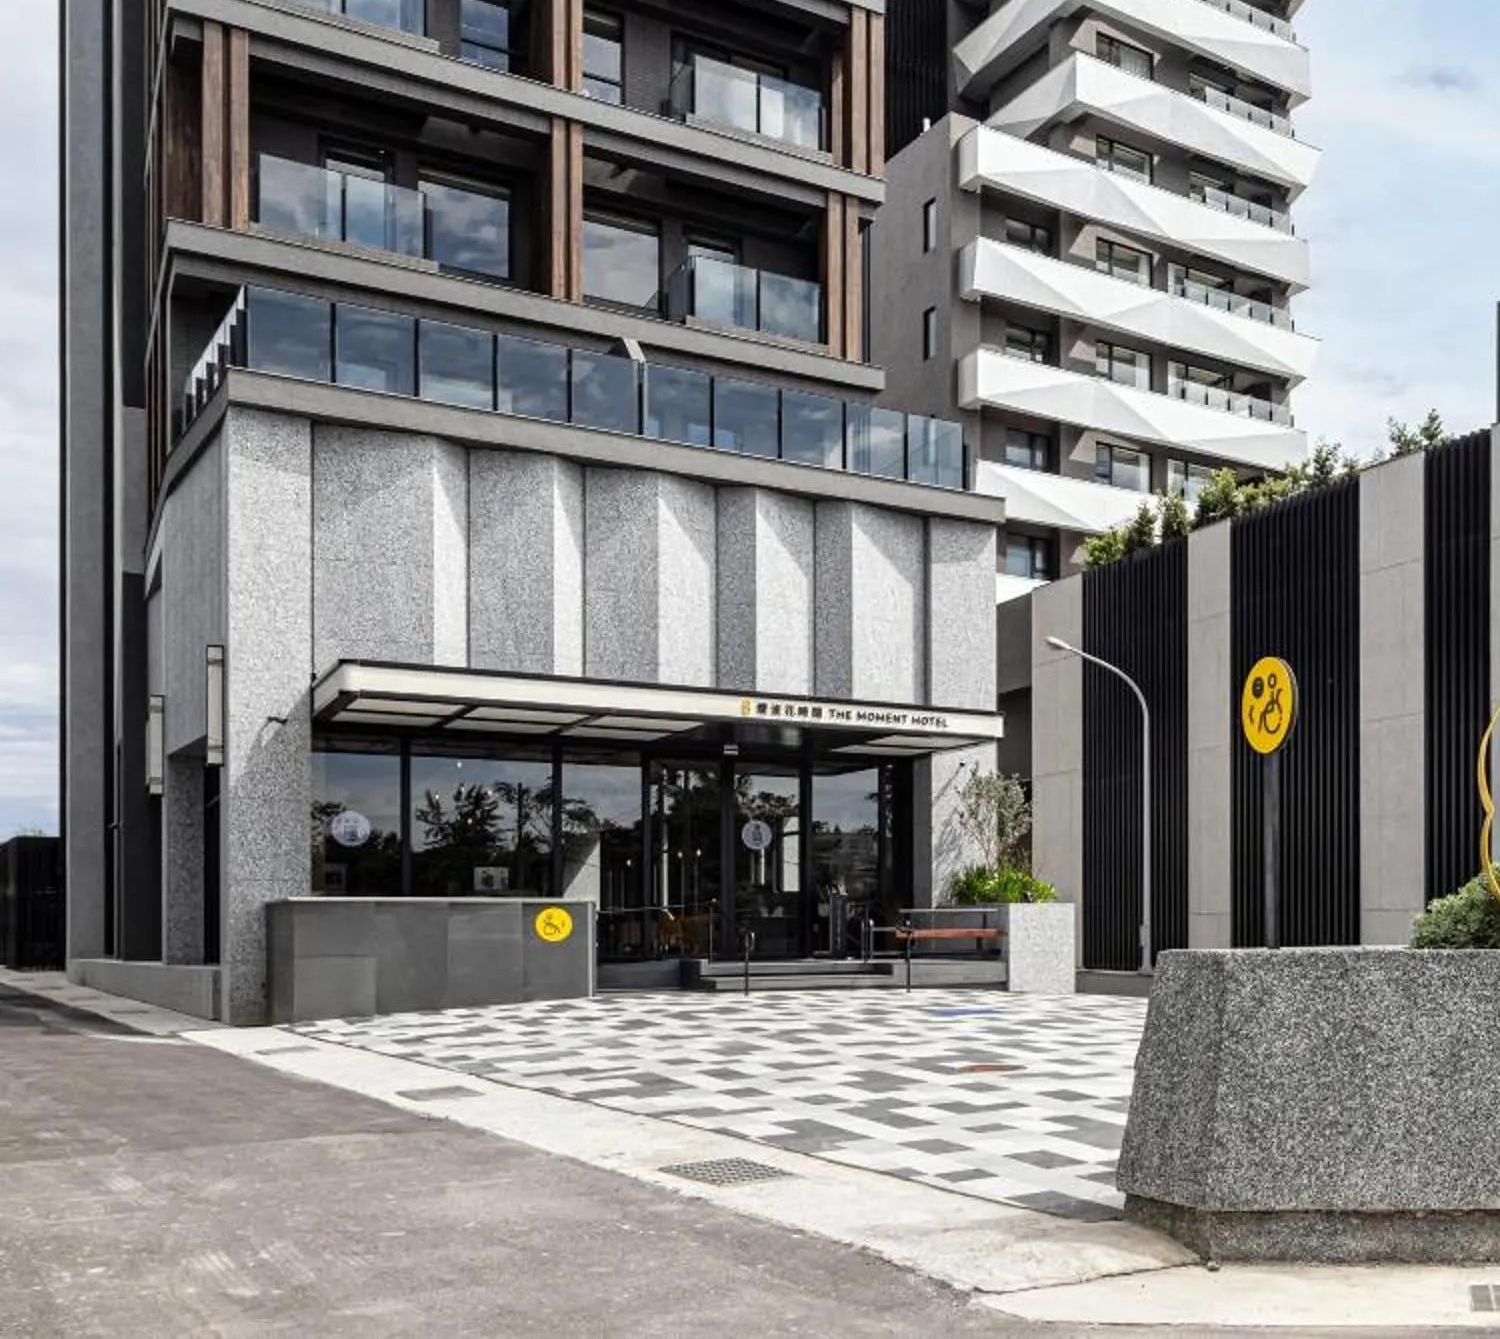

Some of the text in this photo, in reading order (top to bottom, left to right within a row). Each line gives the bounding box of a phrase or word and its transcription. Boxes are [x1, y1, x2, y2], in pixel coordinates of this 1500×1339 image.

[828, 708, 853, 721] THE
[856, 710, 909, 724] MOMENT
[911, 715, 949, 728] HOTEL
